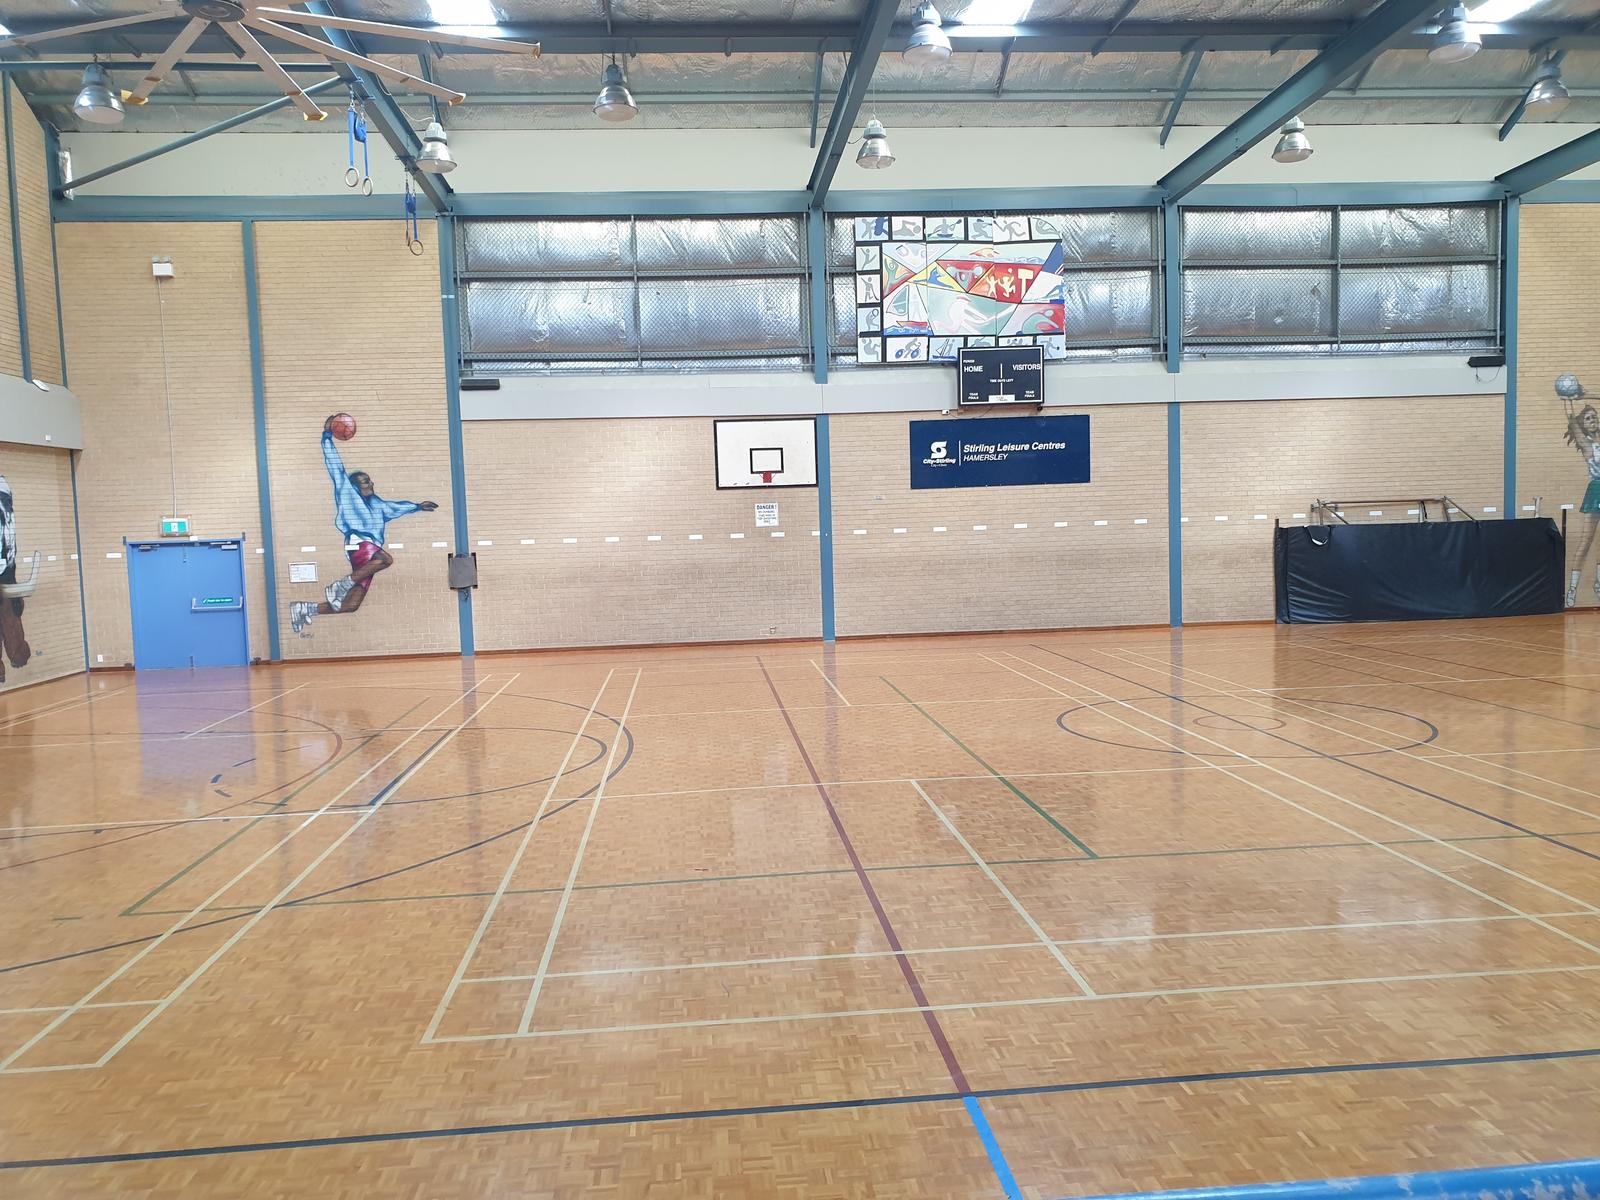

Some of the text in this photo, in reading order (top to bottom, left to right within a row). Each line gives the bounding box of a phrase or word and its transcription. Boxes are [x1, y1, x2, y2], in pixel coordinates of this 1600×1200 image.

[963, 442, 1066, 454] Stirling Leisure Centres
[963, 454, 1008, 462] HAMERSLEY
